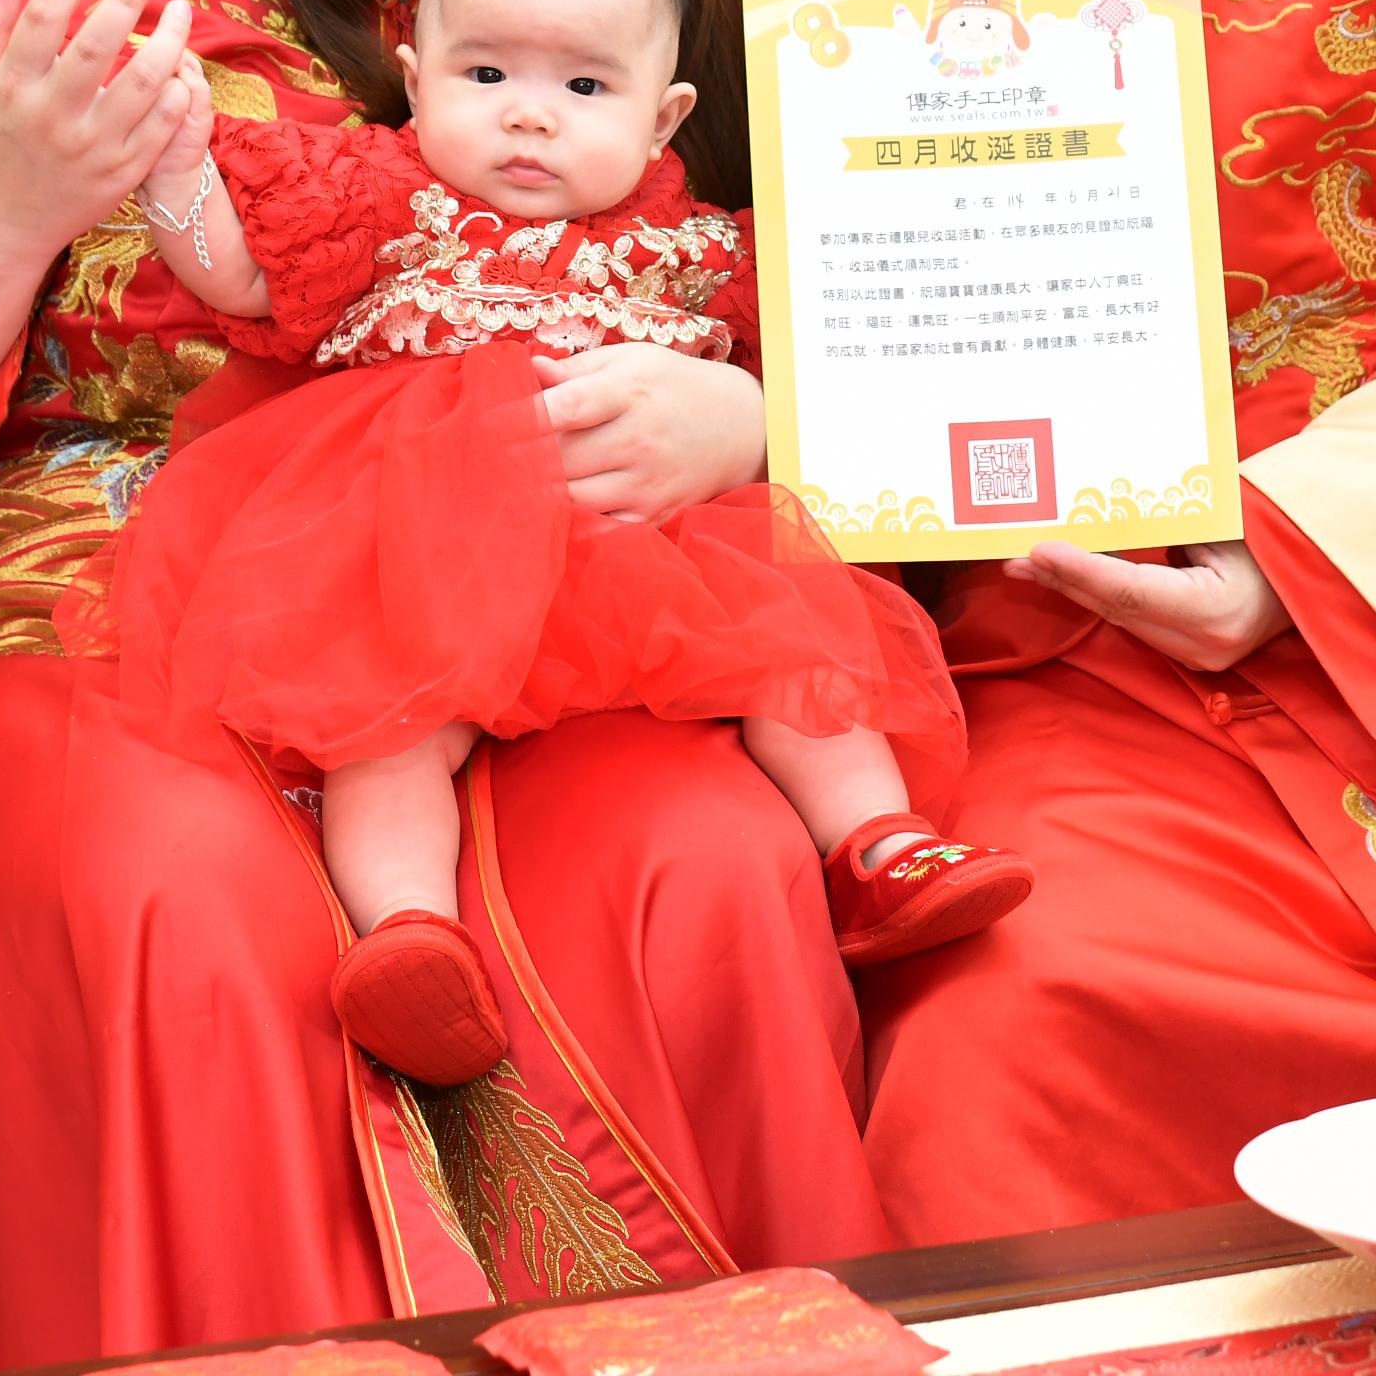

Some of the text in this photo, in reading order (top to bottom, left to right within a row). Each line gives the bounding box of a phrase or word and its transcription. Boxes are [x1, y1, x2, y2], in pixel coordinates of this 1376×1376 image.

[906, 85, 1047, 112] 傳家手工印章
[910, 107, 1045, 124] www.seals.com.tw
[875, 128, 1092, 167] 四月收涎證書
[1044, 192, 1057, 204] 年
[1087, 189, 1098, 202] 月
[1130, 186, 1140, 199] 日
